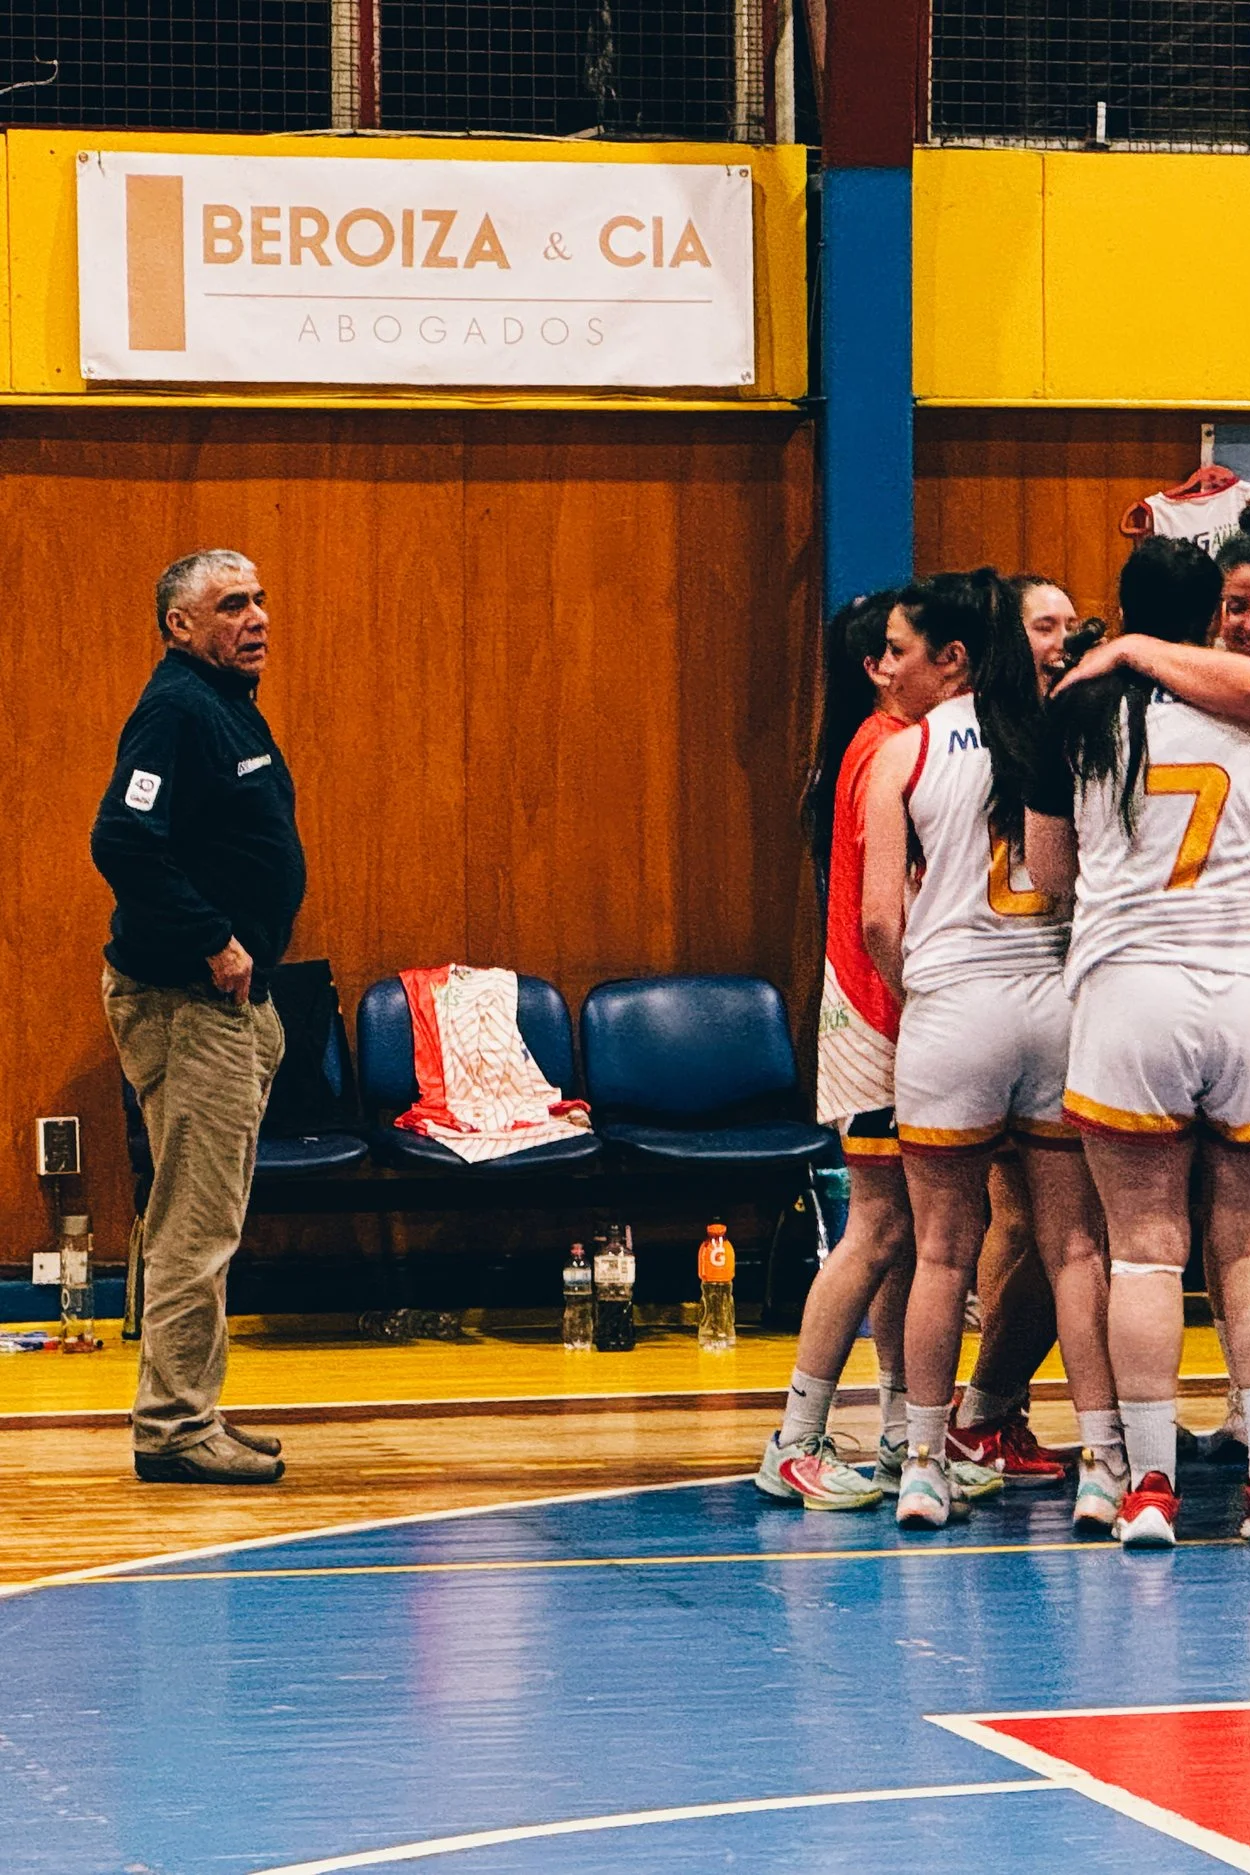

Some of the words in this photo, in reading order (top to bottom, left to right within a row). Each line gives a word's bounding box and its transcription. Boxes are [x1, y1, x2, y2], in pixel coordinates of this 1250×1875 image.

[202, 204, 511, 269] BEROIZA
[543, 231, 571, 261] &
[599, 216, 712, 268] CIA
[298, 314, 604, 346] ABOGADOS
[1144, 762, 1231, 891] 7
